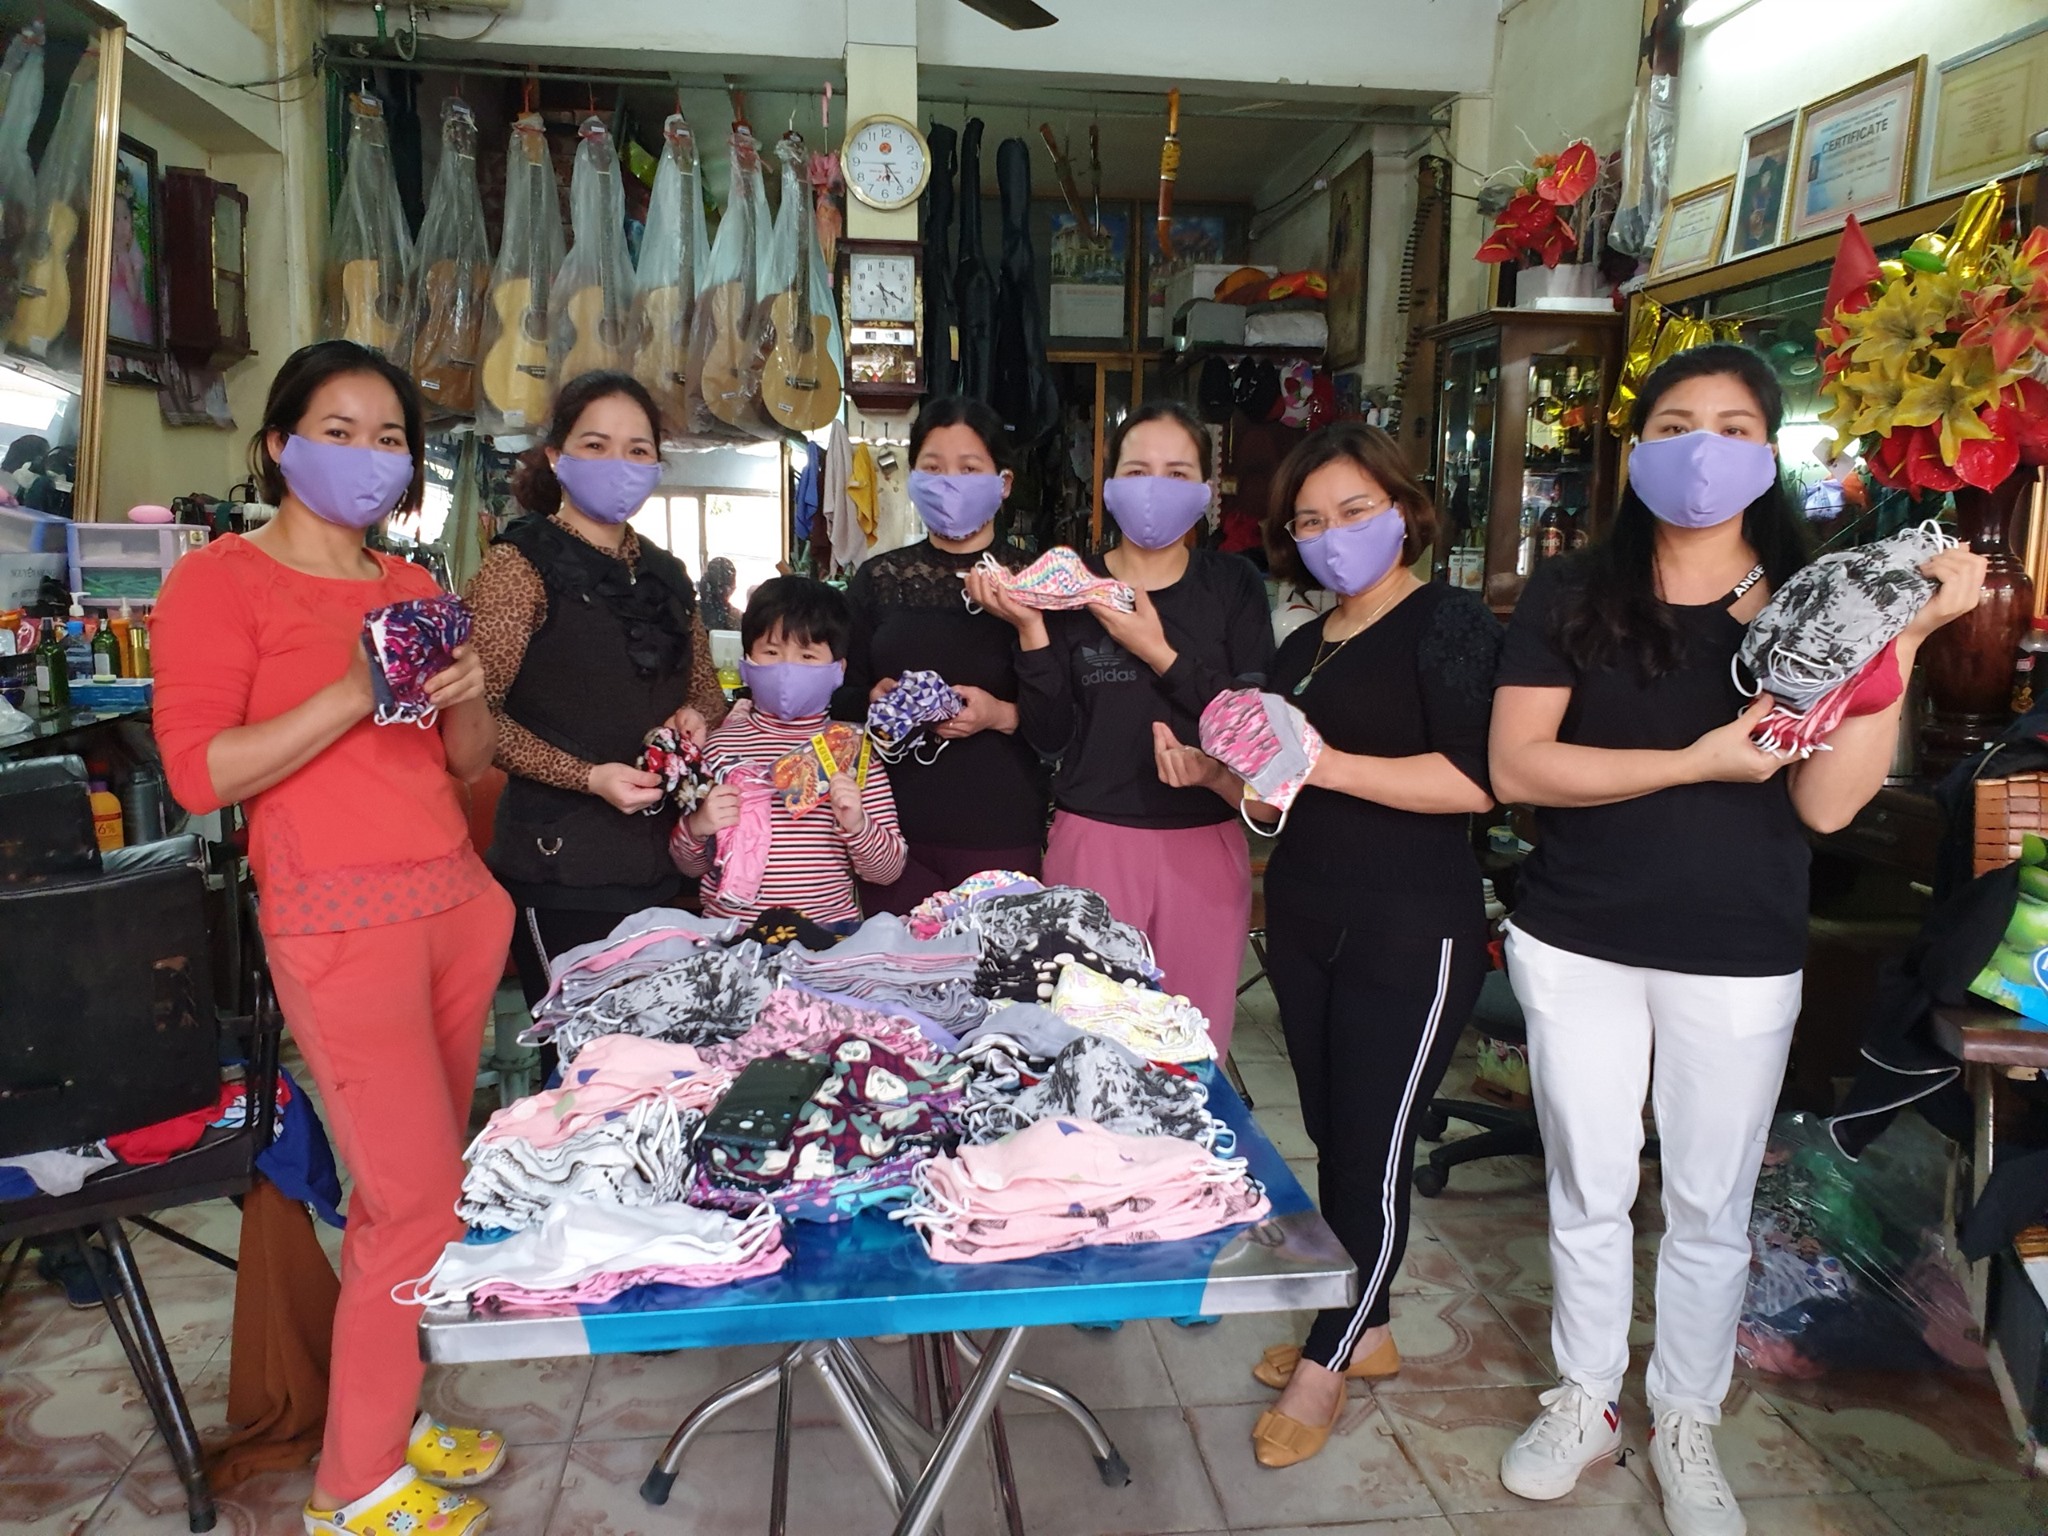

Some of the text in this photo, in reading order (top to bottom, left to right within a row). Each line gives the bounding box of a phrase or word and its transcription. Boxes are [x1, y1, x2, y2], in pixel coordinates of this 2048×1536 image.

[868, 132, 876, 141] 11
[881, 128, 892, 138] 12
[1822, 118, 1889, 154] CERTIFICATE
[899, 134, 903, 143] 1
[857, 142, 868, 152] 10
[906, 145, 914, 155] 2
[852, 156, 861, 167] 9
[911, 161, 919, 170] 3
[856, 172, 865, 182] 8
[906, 176, 914, 185] 4
[868, 183, 874, 193] 7
[896, 186, 904, 195] 5
[881, 189, 889, 199] 6
[1081, 667, 1137, 686] adidas
